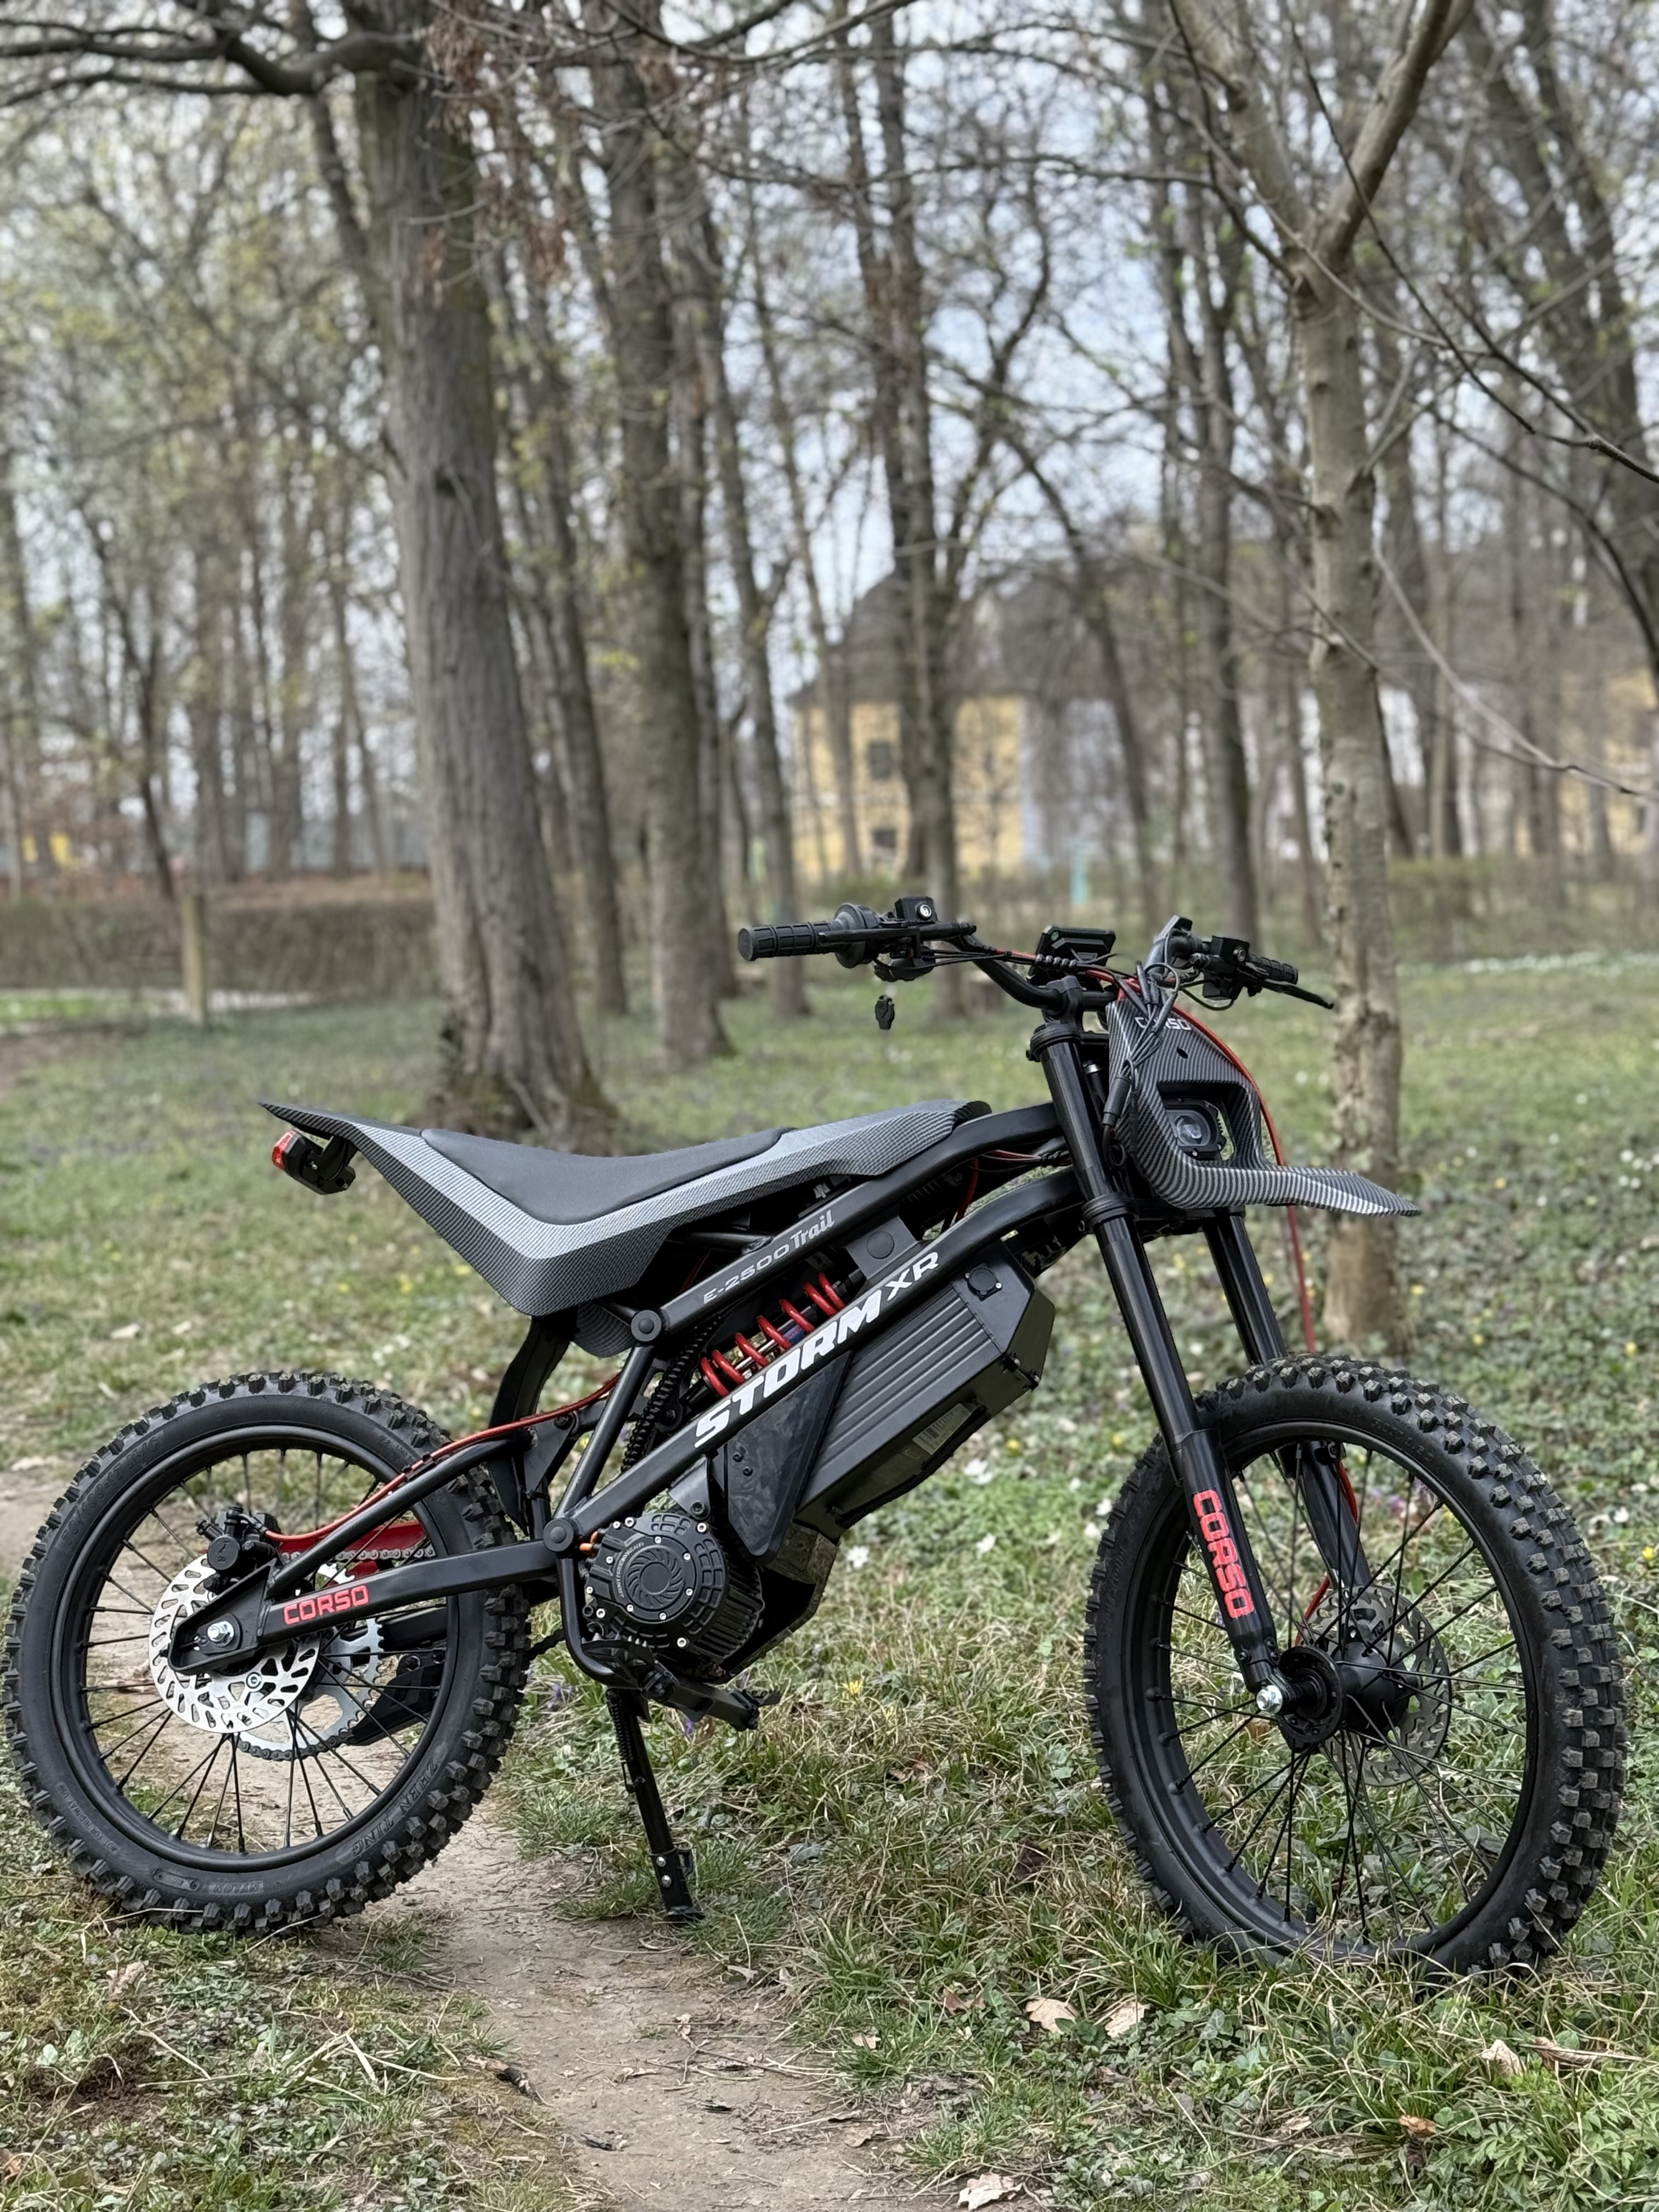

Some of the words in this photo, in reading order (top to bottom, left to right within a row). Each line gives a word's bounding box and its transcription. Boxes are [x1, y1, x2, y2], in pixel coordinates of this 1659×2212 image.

[1135, 1017, 1192, 1030] CSO
[704, 1244, 789, 1304] E-2500
[791, 1210, 834, 1249] Trail
[695, 1289, 881, 1448] STORM
[884, 1251, 940, 1301] XR
[1193, 1490, 1254, 1618] CORSO
[284, 1585, 370, 1626] CORSO
[67, 1799, 92, 1827] HIGHWAY
[90, 1827, 104, 1841] FOR
[105, 1839, 118, 1853] NOT
[213, 1882, 260, 1894] NYLON
